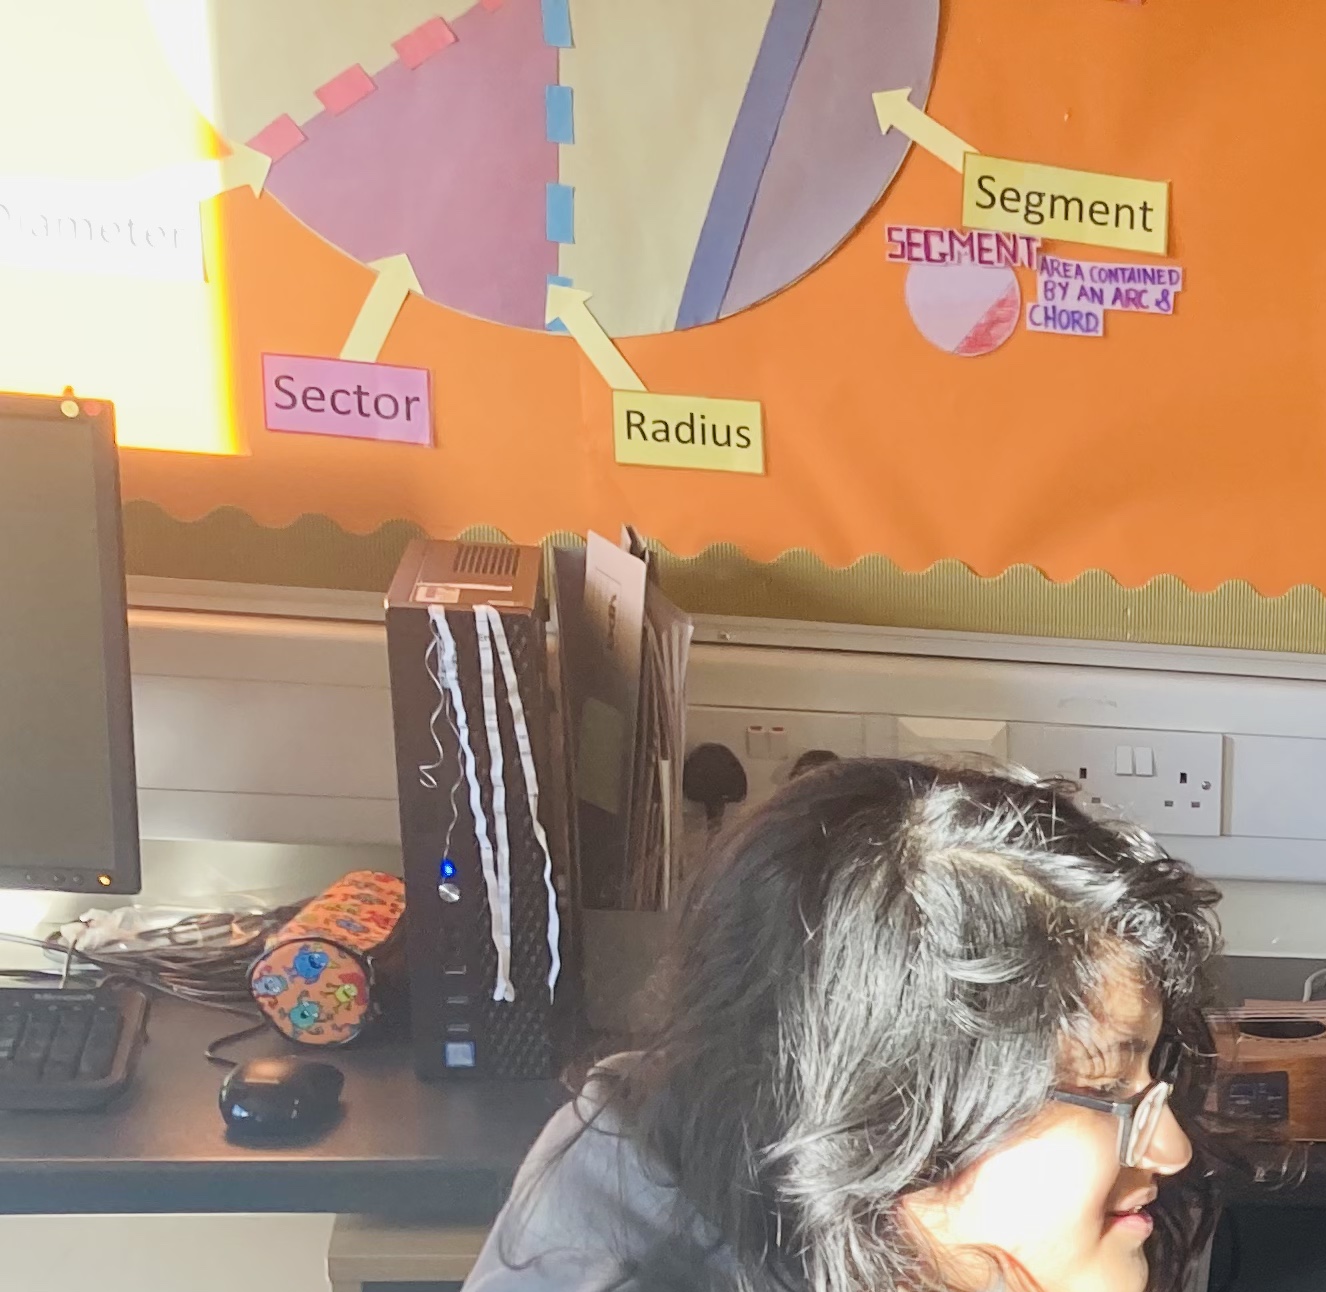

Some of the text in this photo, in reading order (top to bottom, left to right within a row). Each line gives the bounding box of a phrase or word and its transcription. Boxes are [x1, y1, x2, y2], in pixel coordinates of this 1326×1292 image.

[975, 174, 1154, 233] Segment
[887, 226, 1040, 269] SEGMENT
[1040, 256, 1181, 287] AREA CONTAINED
[1042, 281, 1171, 312] BY AN ARC &
[273, 374, 421, 422] Sector
[625, 409, 753, 449] Radius
